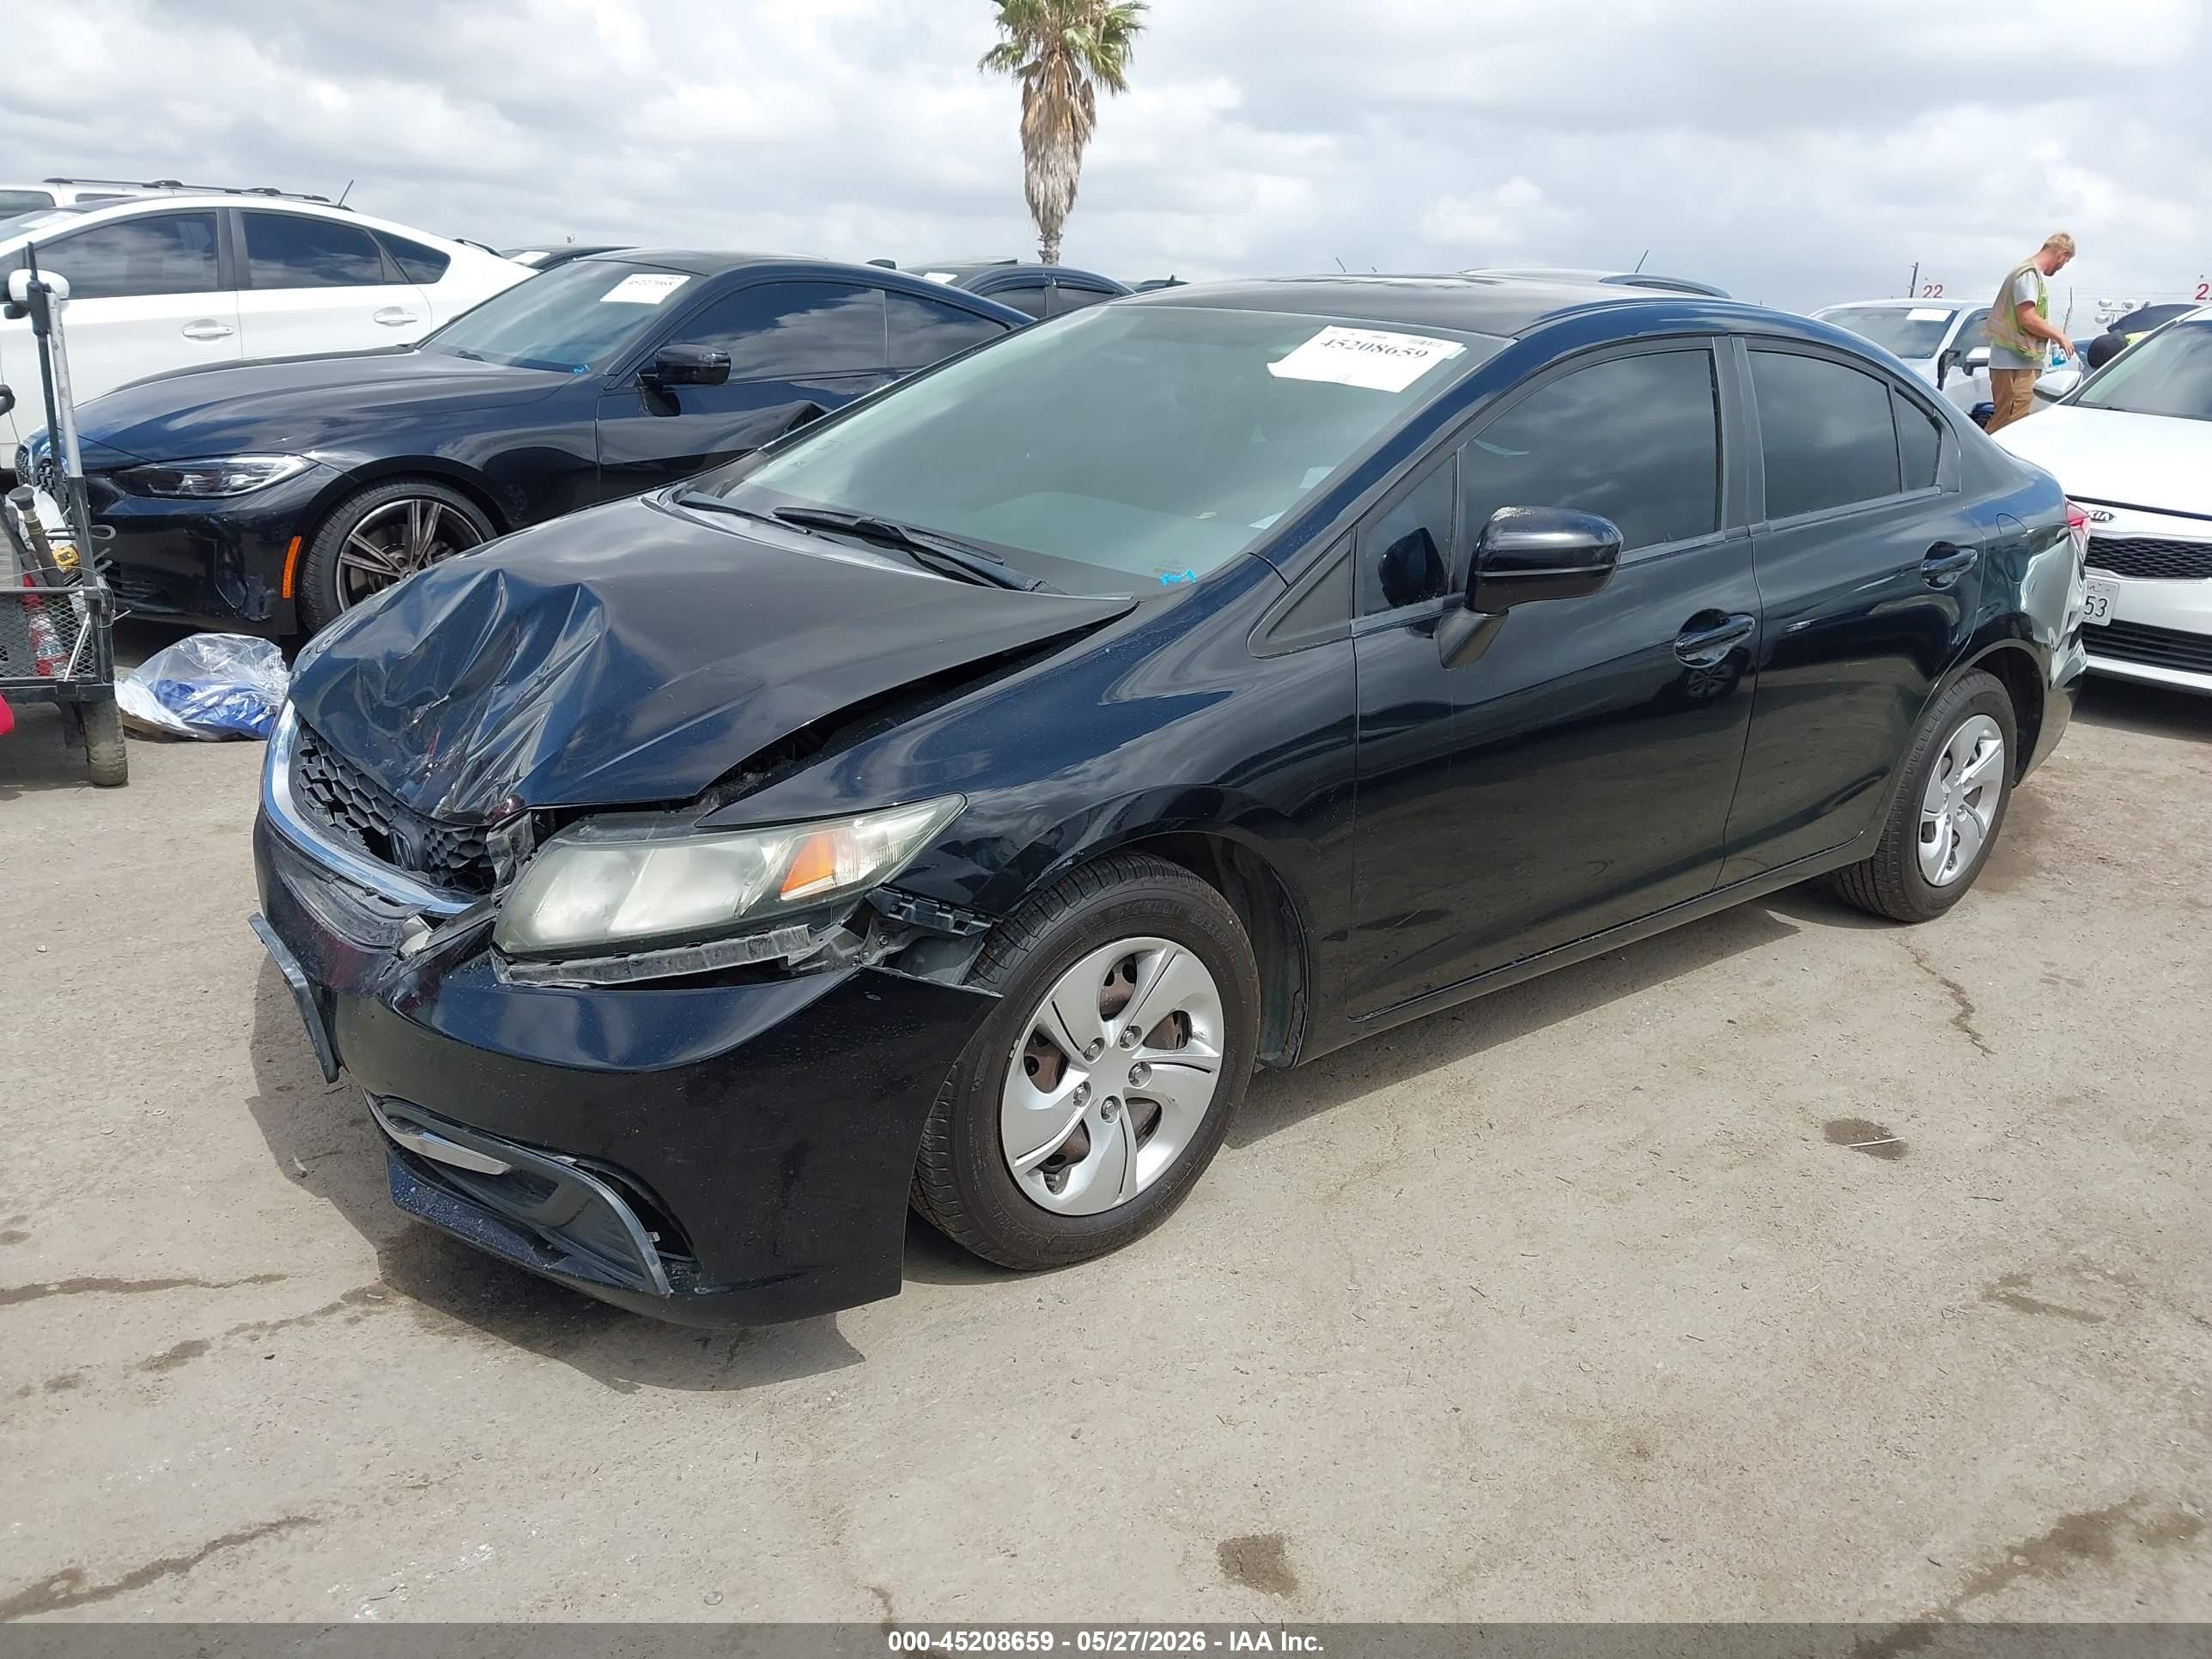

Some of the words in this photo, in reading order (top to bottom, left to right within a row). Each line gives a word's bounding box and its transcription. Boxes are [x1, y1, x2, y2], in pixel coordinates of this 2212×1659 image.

[1923, 284, 1943, 299] 22
[2195, 283, 2212, 300] 2
[1321, 338, 1429, 359] 45208659
[2084, 595, 2108, 617] 53
